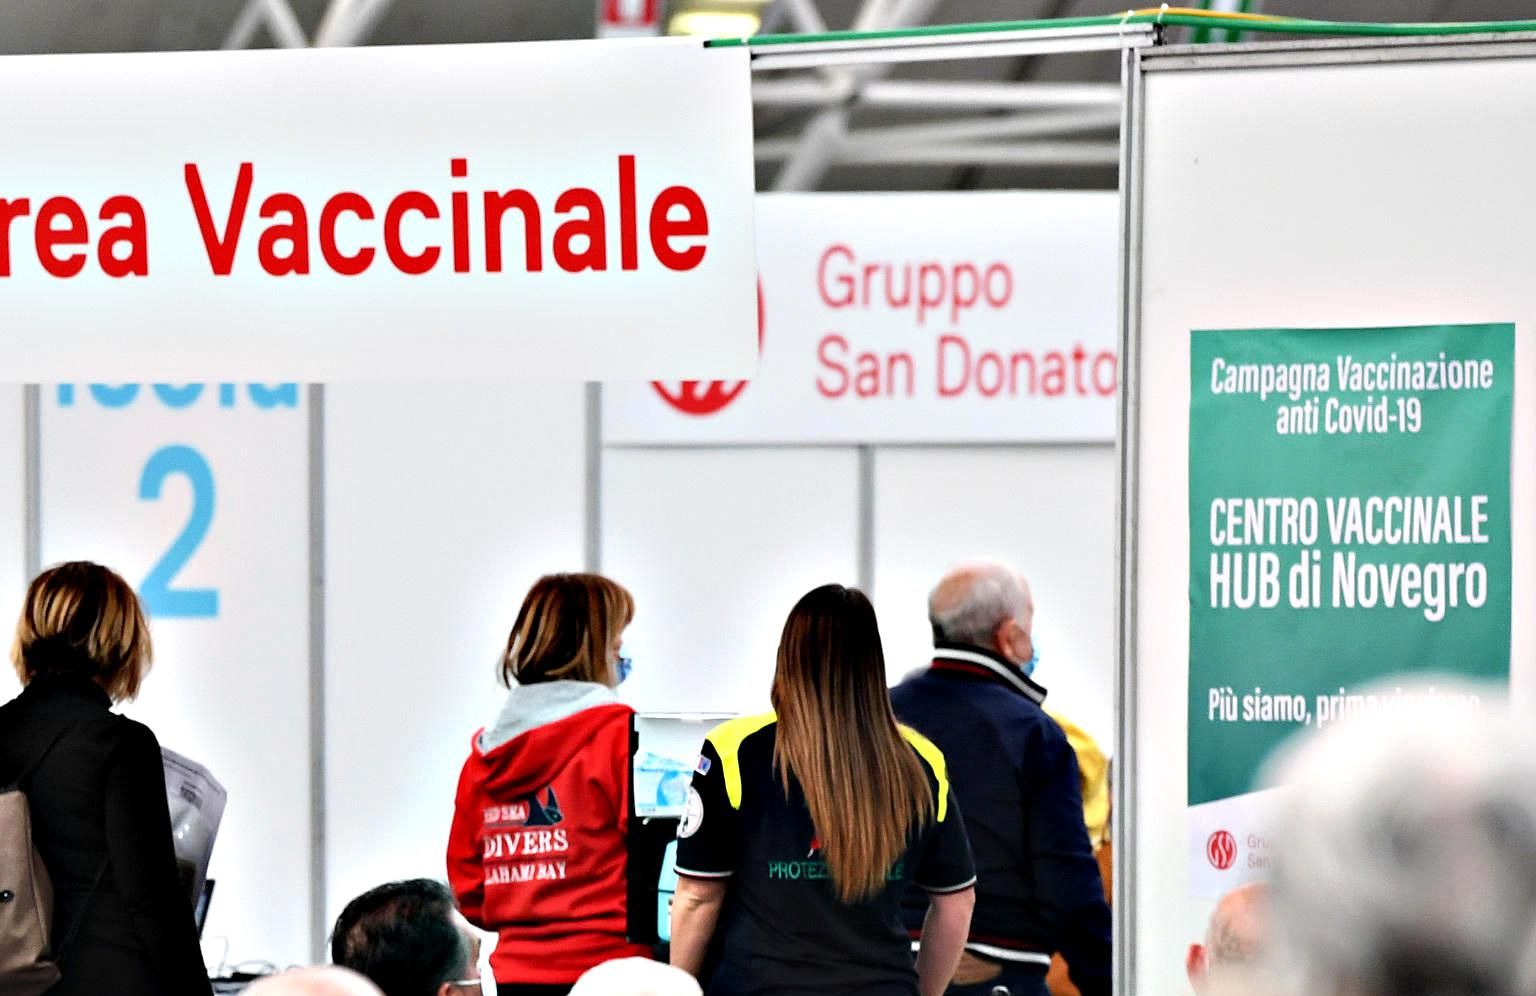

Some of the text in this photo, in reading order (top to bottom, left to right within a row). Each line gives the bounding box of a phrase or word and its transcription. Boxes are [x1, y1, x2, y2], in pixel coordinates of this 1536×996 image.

[183, 155, 711, 278] Vaccinale
[816, 243, 1014, 327] Gruppo
[816, 333, 1117, 400] San Donato
[1210, 354, 1494, 401] Campagna Vaccinazione
[1276, 396, 1422, 436] anti Covid-19
[139, 443, 220, 618] 2
[1209, 495, 1489, 546] CENTRO VACCINALE
[1209, 549, 1489, 623] HUB di Novegro
[1208, 686, 1238, 722] Più
[1242, 687, 1312, 725] siamo,
[483, 828, 569, 859] DIVERS
[768, 861, 827, 880] PROTEZ
